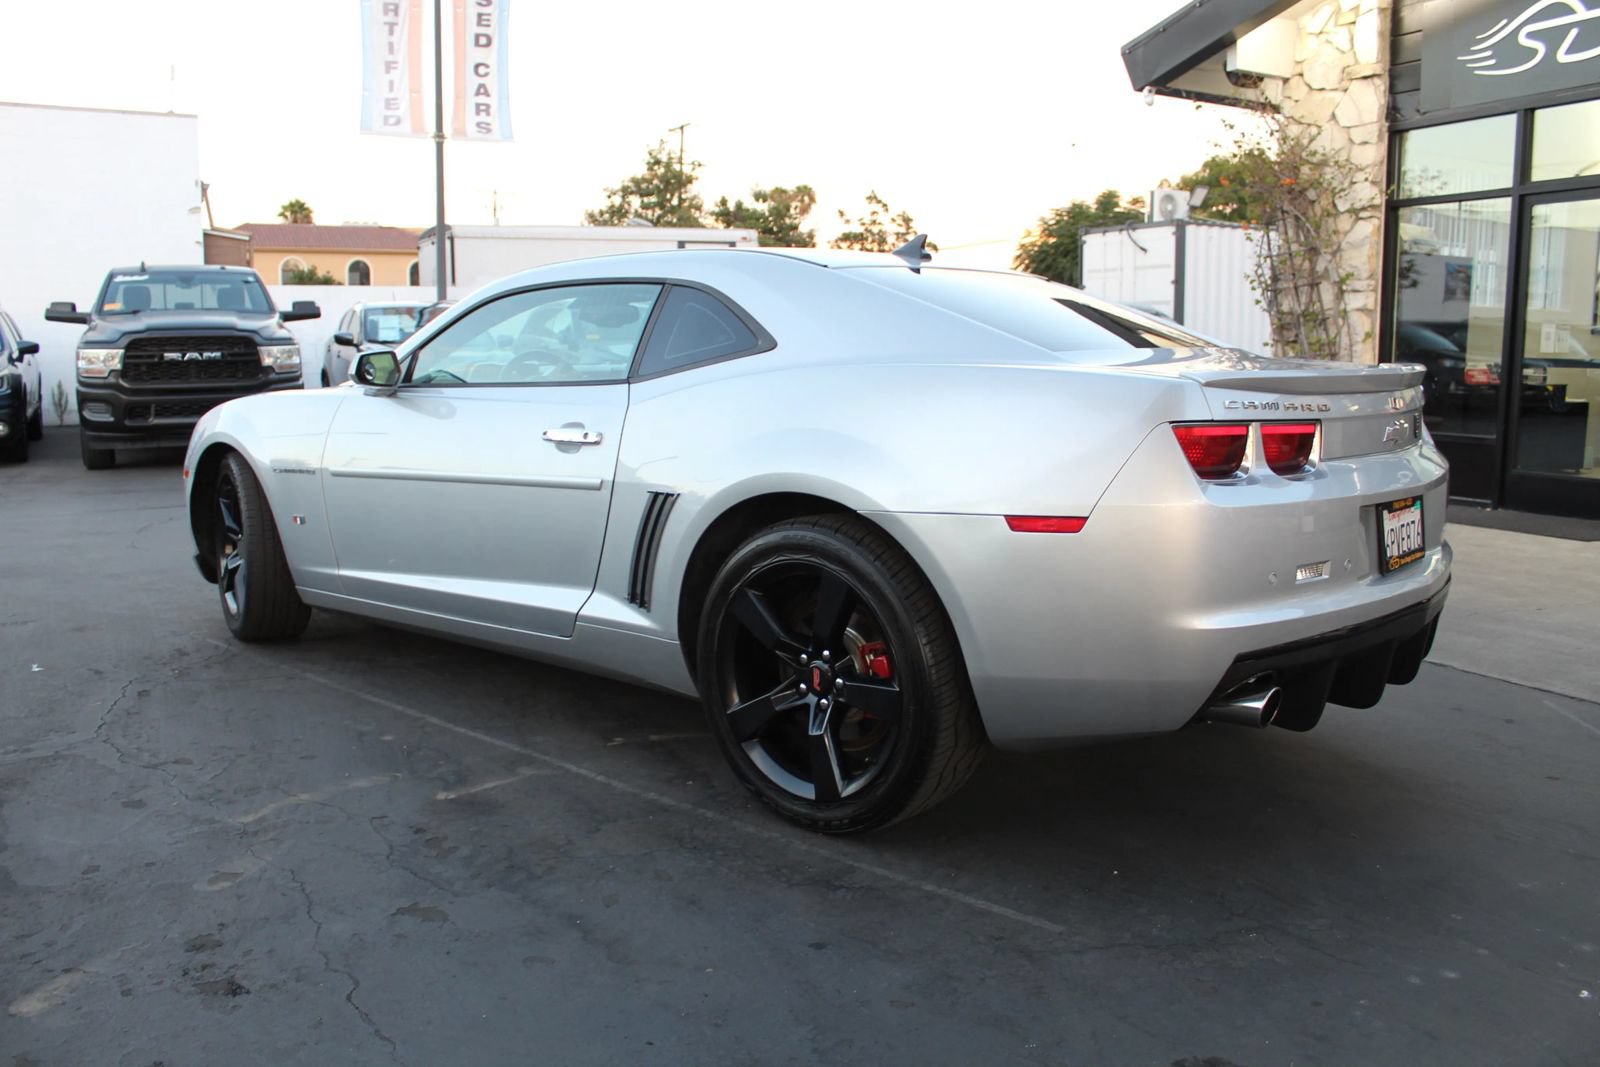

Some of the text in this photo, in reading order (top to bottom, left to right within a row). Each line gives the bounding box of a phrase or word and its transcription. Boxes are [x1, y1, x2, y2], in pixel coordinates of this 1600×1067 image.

[473, 62, 493, 135] CARS
[163, 352, 222, 361] RAM
[1223, 400, 1331, 413] CAMARO
